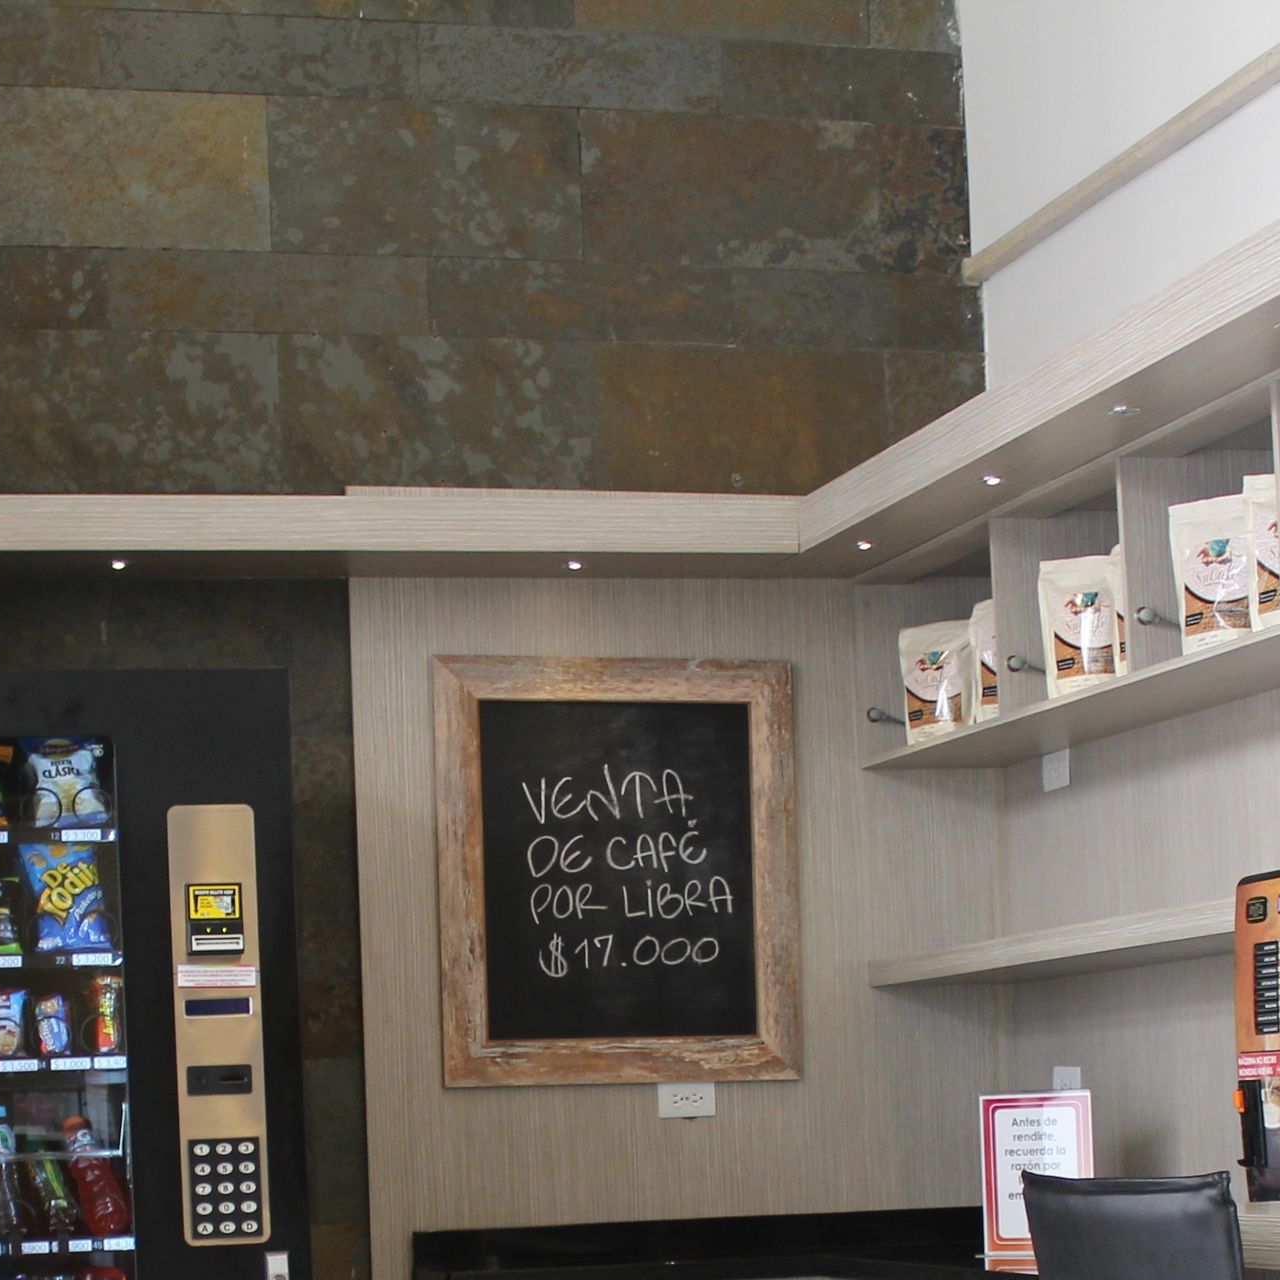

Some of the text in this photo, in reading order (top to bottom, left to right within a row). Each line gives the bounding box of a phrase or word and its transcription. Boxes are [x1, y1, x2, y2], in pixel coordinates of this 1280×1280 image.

[522, 763, 694, 824] VENTA
[527, 819, 707, 877] DE CAFÉ
[530, 883, 608, 924] POR
[1011, 1116, 1058, 1127] Antes de
[1004, 1145, 1066, 1157] recuerda la
[1010, 1160, 1061, 1173] razón por
